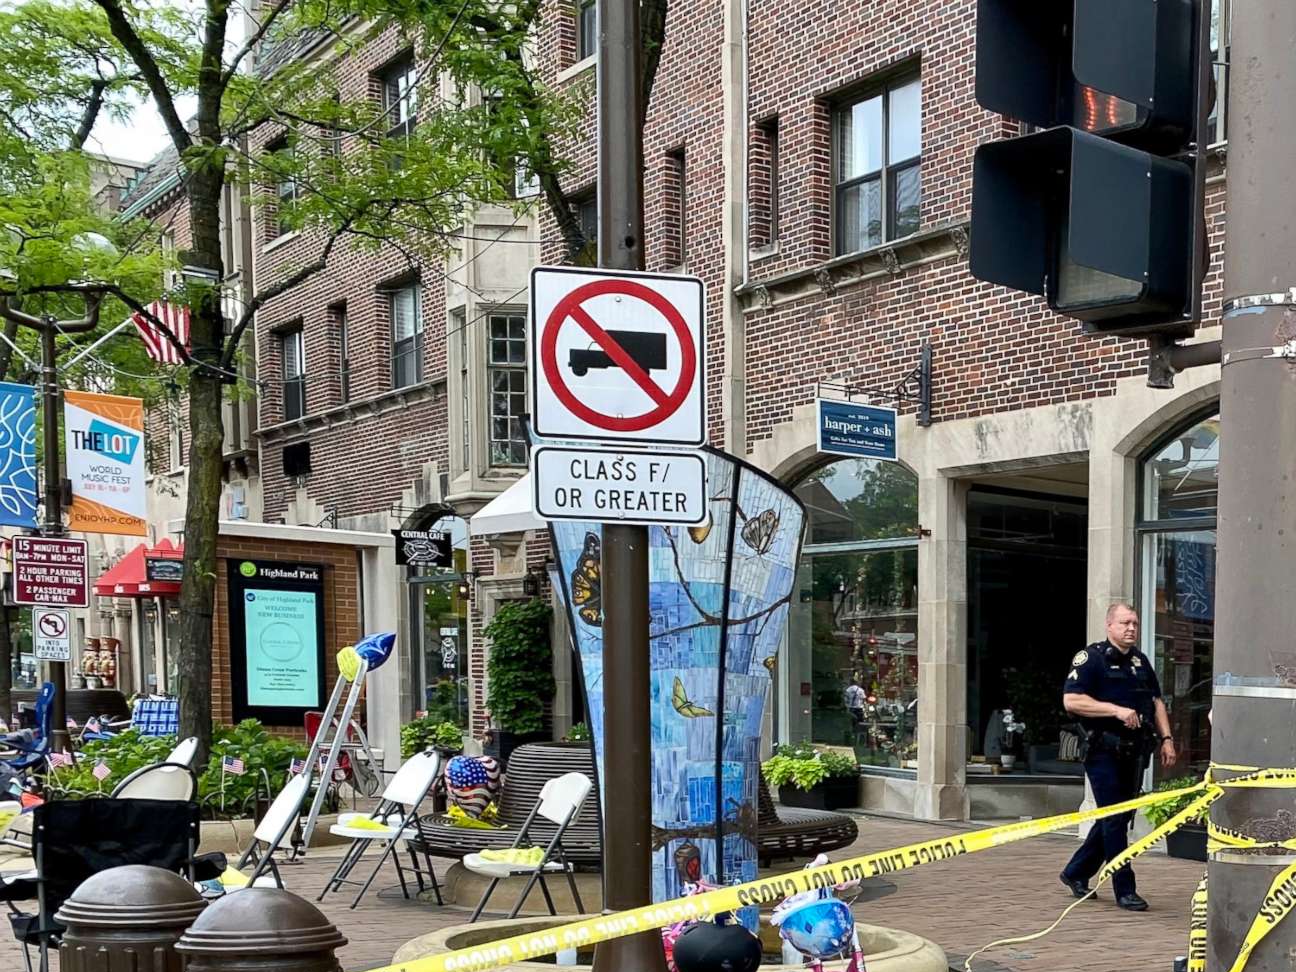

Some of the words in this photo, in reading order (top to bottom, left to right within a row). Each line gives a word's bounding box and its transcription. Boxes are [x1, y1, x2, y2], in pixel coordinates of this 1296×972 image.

[824, 415, 862, 434] harper
[872, 424, 892, 437] ash
[89, 465, 122, 475] WORLD
[570, 459, 637, 482] CLASS
[649, 463, 671, 484] F/
[81, 474, 109, 484] MUSIC
[111, 476, 131, 485] FEST
[554, 488, 582, 509] OR
[594, 490, 688, 513] GREATER
[401, 530, 428, 540] CENTRAL
[429, 532, 446, 541] CAFE
[18, 540, 30, 551] 15
[33, 544, 60, 553] MINUTE
[62, 546, 82, 555] LIMIT
[19, 574, 32, 582] ALL
[35, 576, 60, 584] OTHER
[62, 577, 83, 585] TIMES
[27, 567, 47, 575] HOUR
[50, 569, 82, 577] PARKING
[260, 568, 298, 579] Highland
[300, 571, 319, 580] Park
[26, 586, 32, 594] 2
[33, 586, 77, 596] PASSENGER
[911, 839, 968, 866] POLICE
[841, 863, 866, 883] DO
[868, 853, 907, 876] LINE
[805, 872, 837, 892] NOT
[737, 880, 797, 907] CROSS
